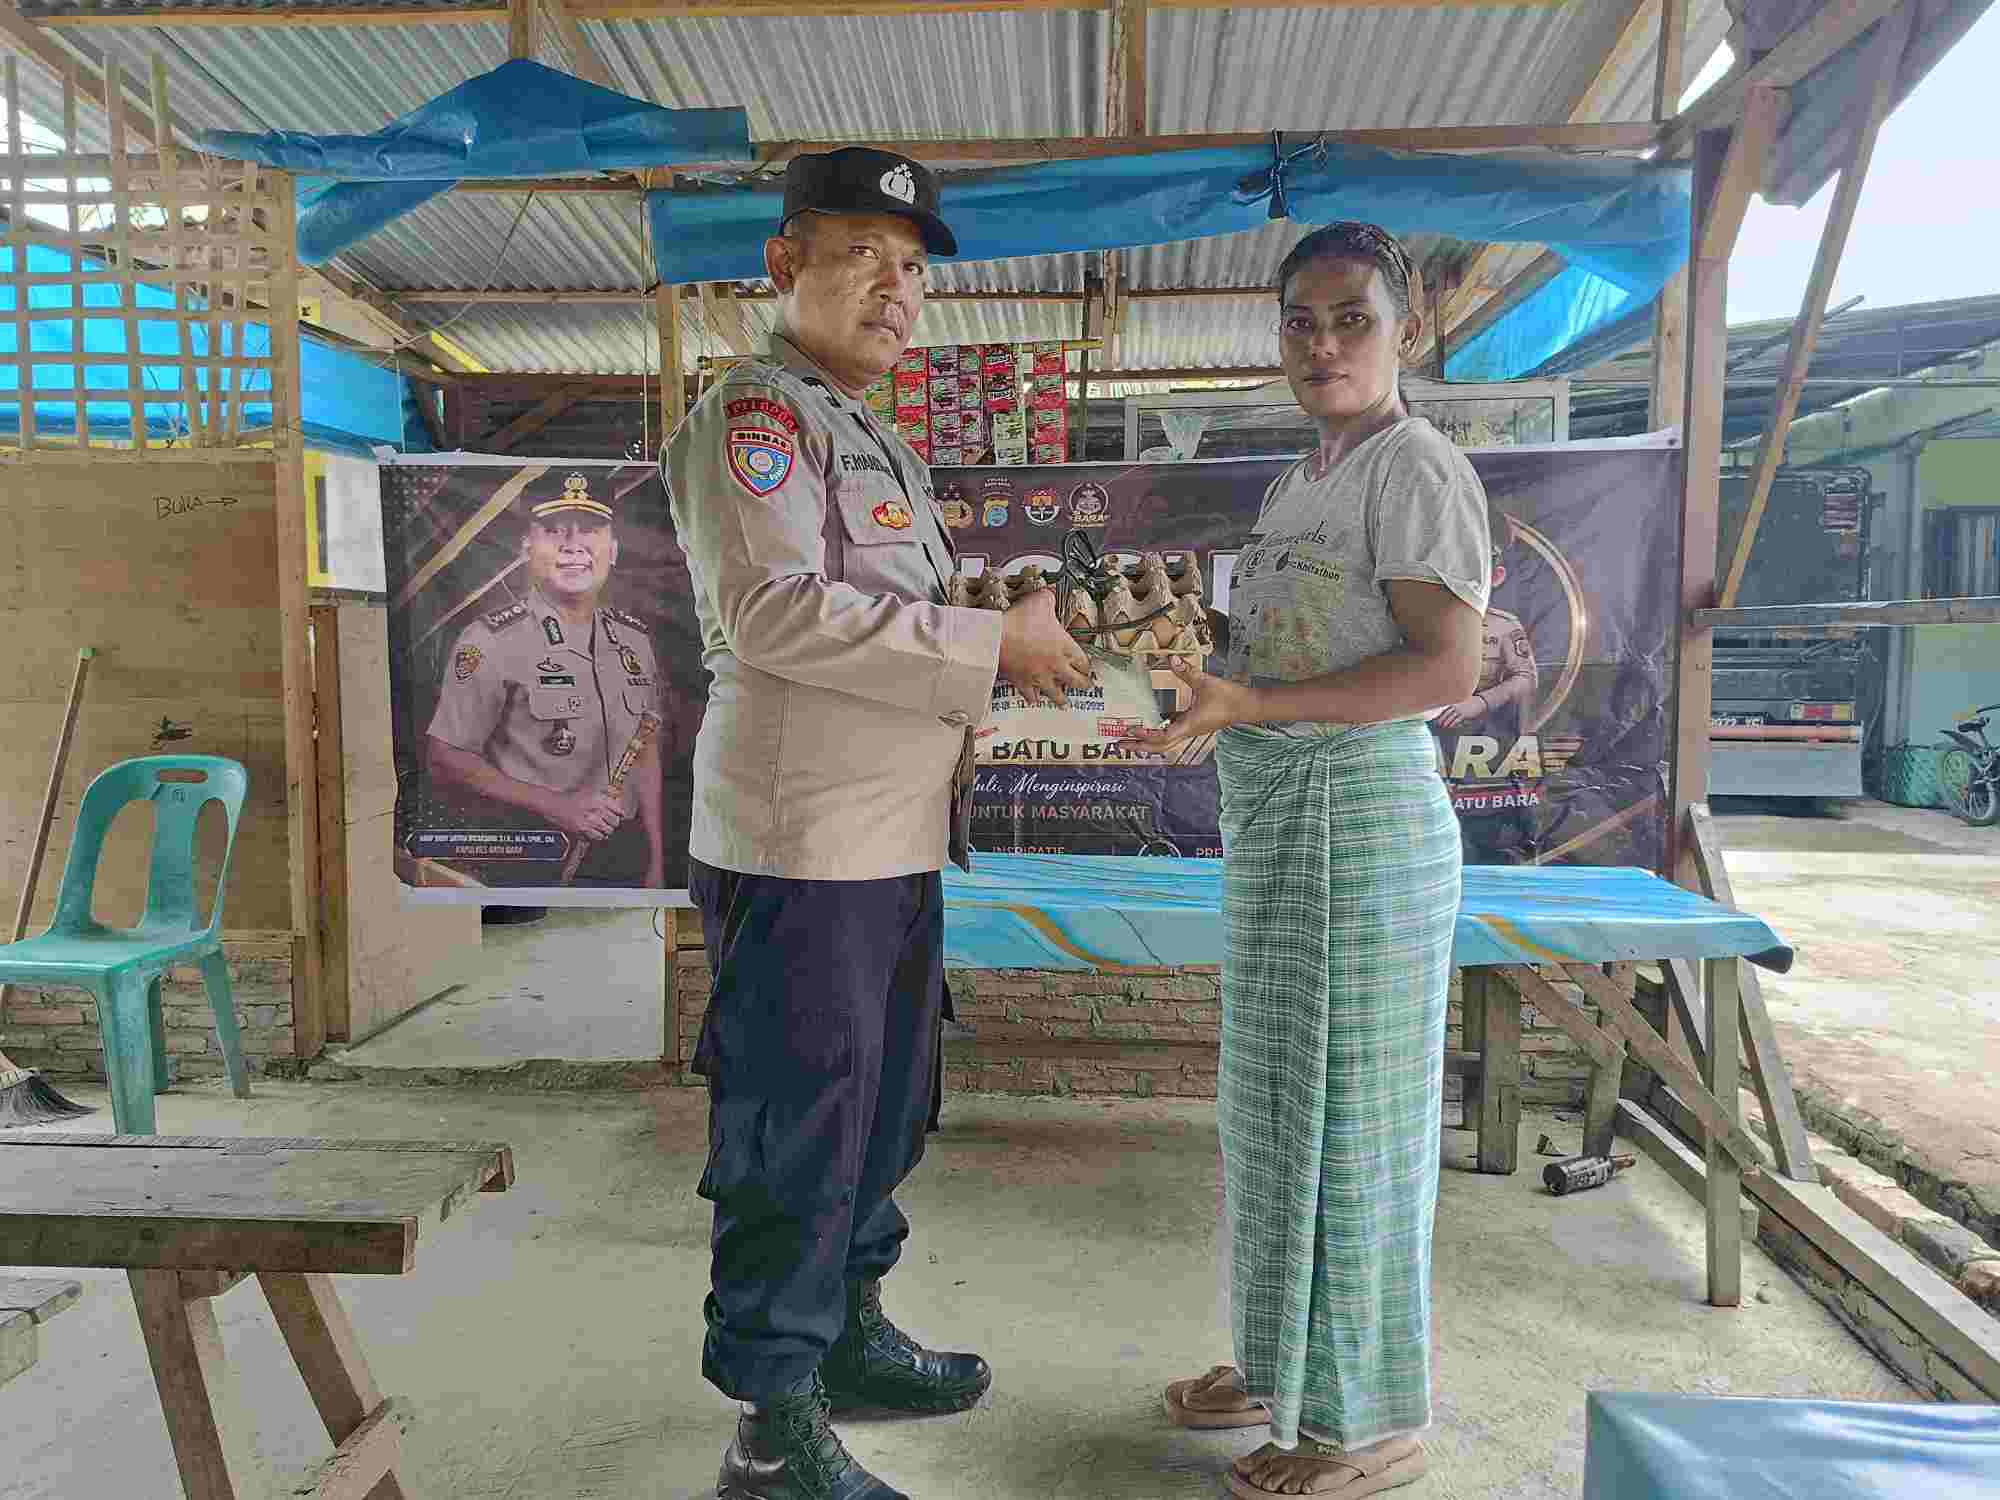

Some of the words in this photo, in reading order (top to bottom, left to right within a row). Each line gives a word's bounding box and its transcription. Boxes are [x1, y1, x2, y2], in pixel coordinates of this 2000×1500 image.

[992, 741, 1071, 760] BATU
[1437, 735, 1541, 778] RA
[1008, 772, 1128, 800] Menginspirasi
[1453, 797, 1487, 809] ATU
[1491, 793, 1539, 809] BARA
[1031, 804, 1149, 820] MASYARAKAT
